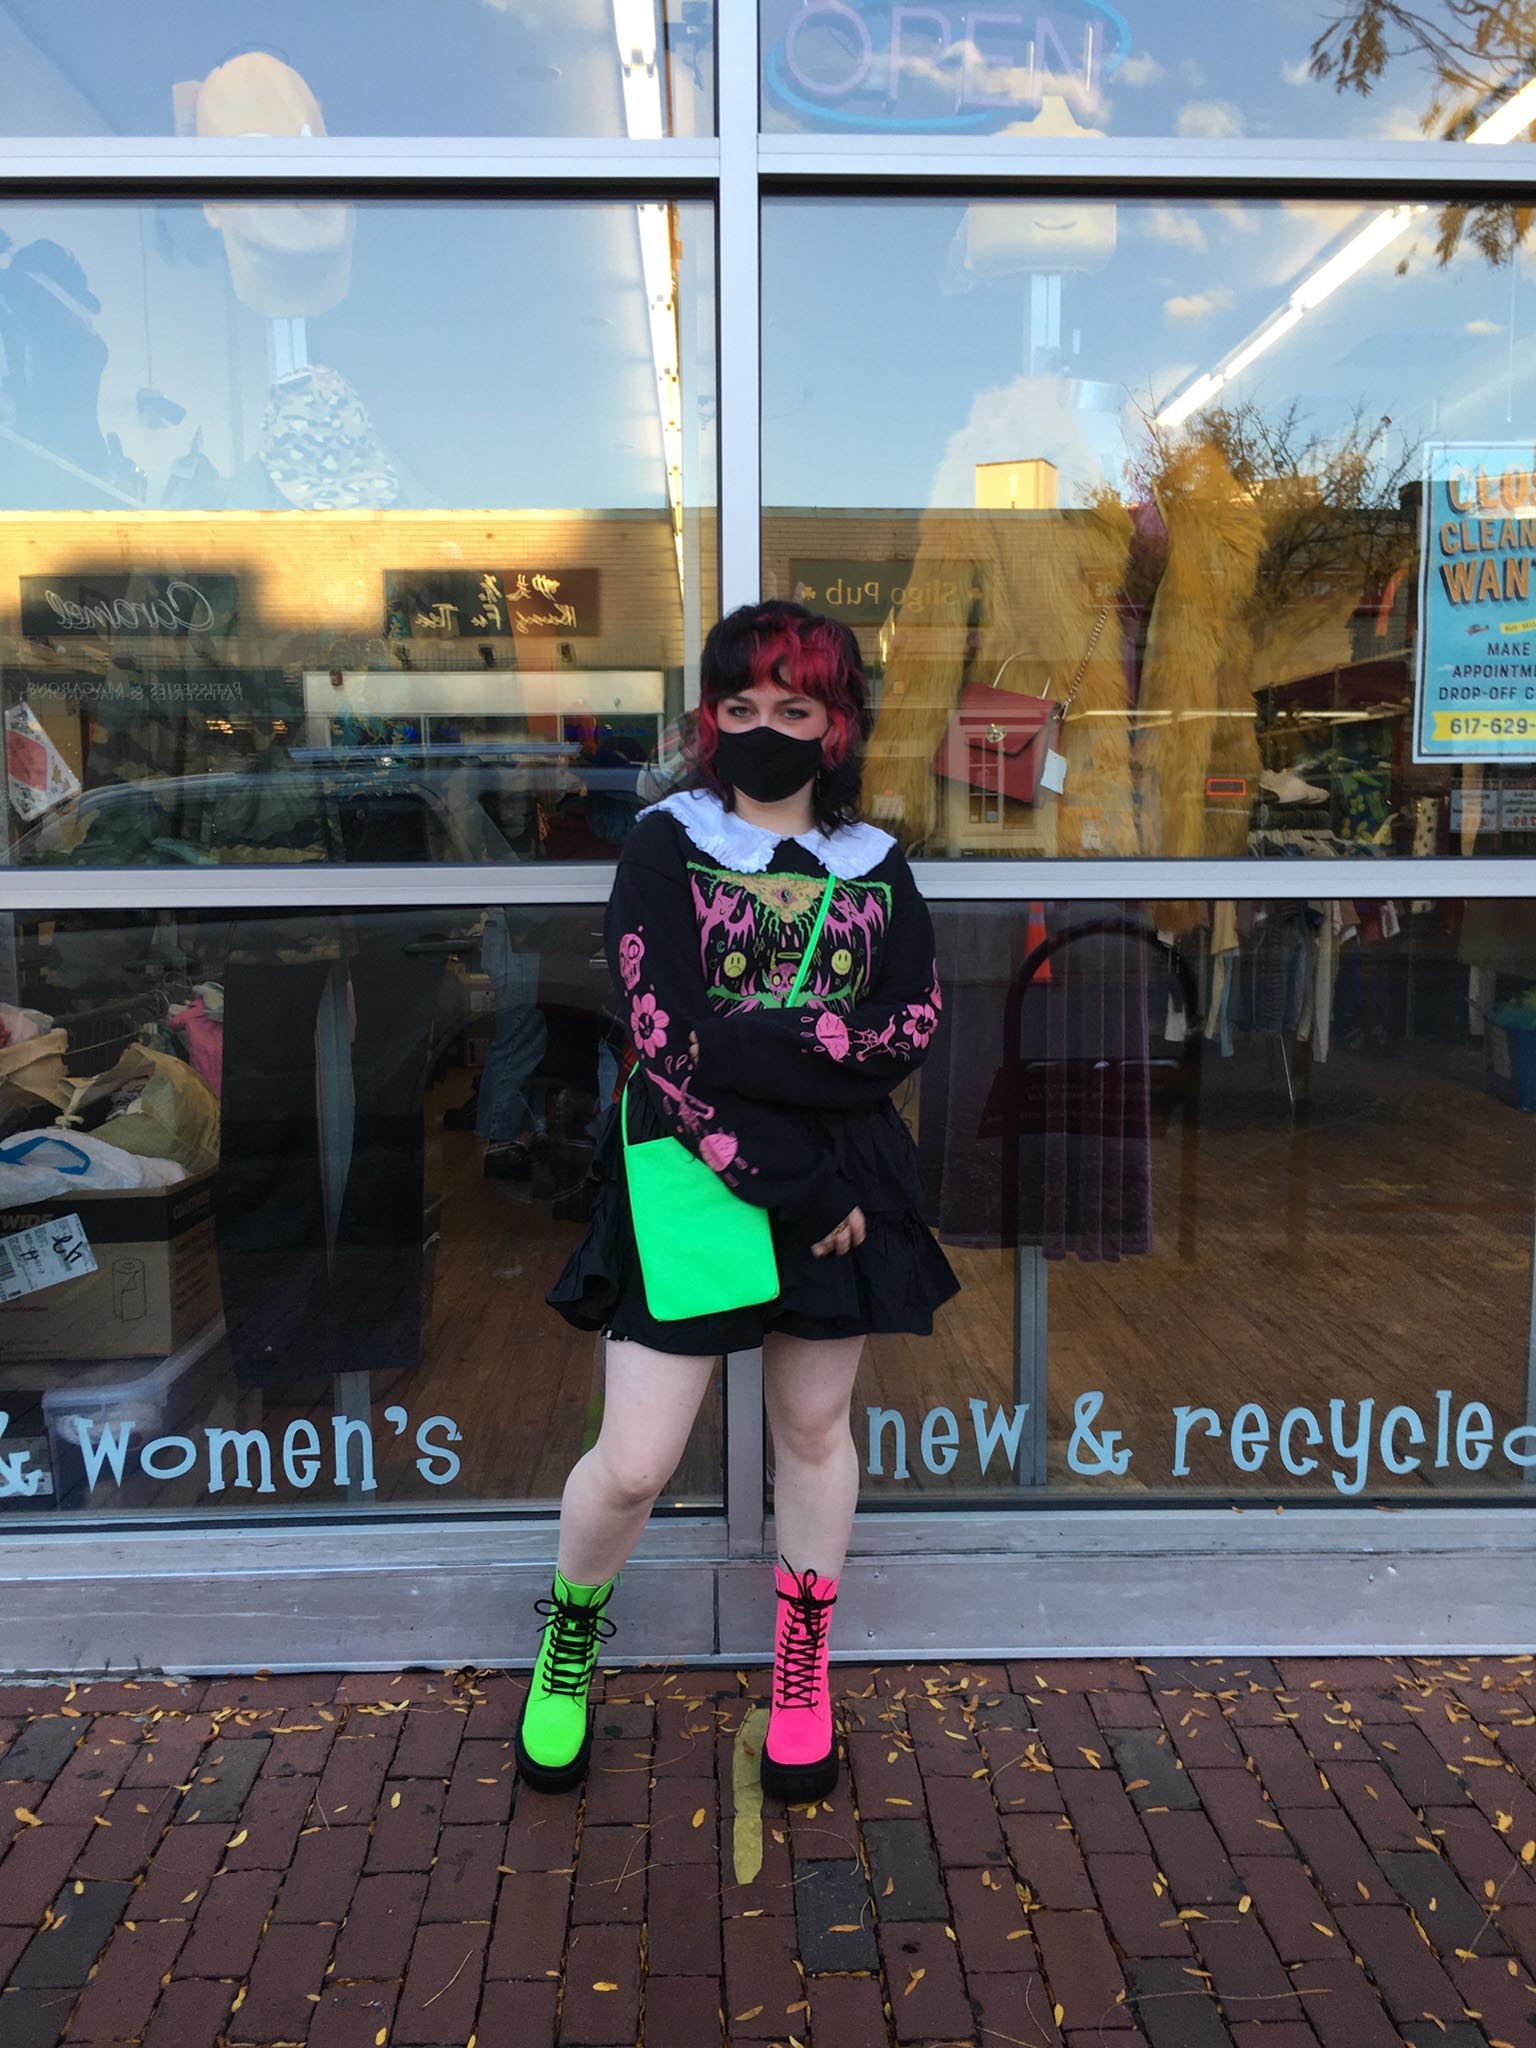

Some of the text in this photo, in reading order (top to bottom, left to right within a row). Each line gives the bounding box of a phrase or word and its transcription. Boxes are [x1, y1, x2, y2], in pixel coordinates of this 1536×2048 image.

[784, 0, 1105, 113] OPEN
[1446, 464, 1536, 514] CLO
[1439, 557, 1536, 606] WAN
[1488, 642, 1530, 657] MAKE
[1439, 686, 1517, 701] DROP-OFF
[73, 1406, 463, 1494] Women's
[867, 1397, 1030, 1479] new
[1066, 1390, 1133, 1476] &
